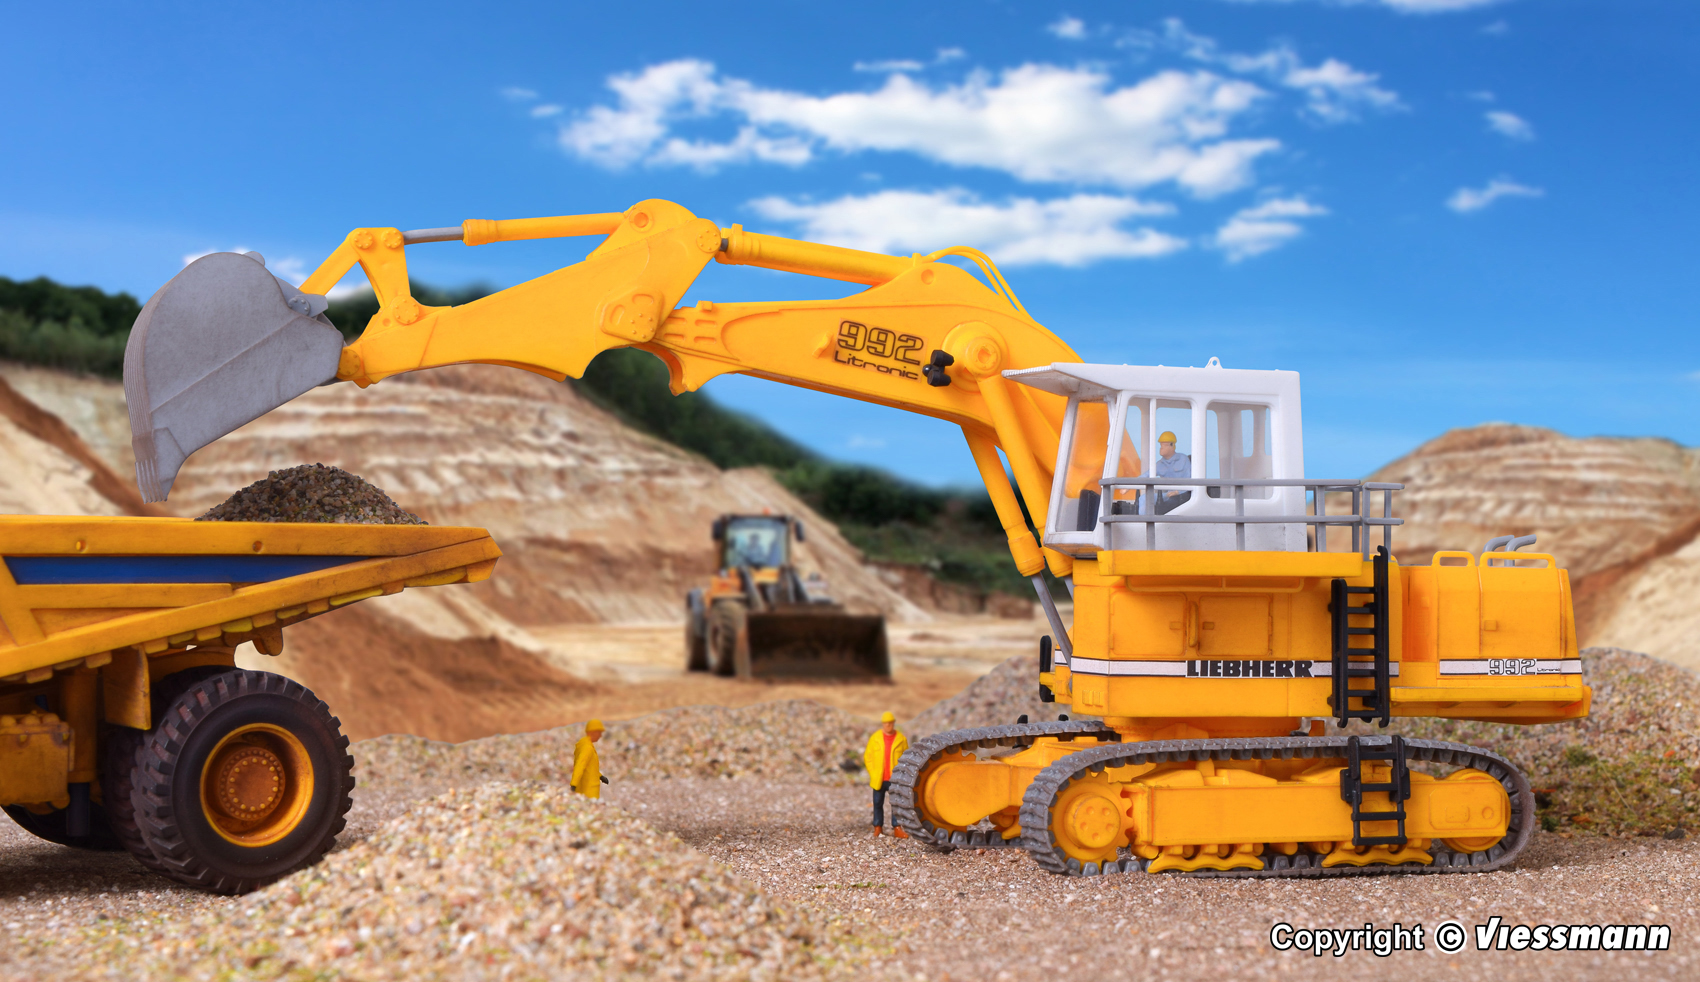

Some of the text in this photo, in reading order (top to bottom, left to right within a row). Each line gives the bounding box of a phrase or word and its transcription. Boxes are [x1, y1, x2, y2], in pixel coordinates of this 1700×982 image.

[837, 320, 924, 366] 992
[834, 350, 919, 380] Litronic
[1186, 660, 1313, 678] LIEBHERR
[1489, 659, 1536, 675] 992
